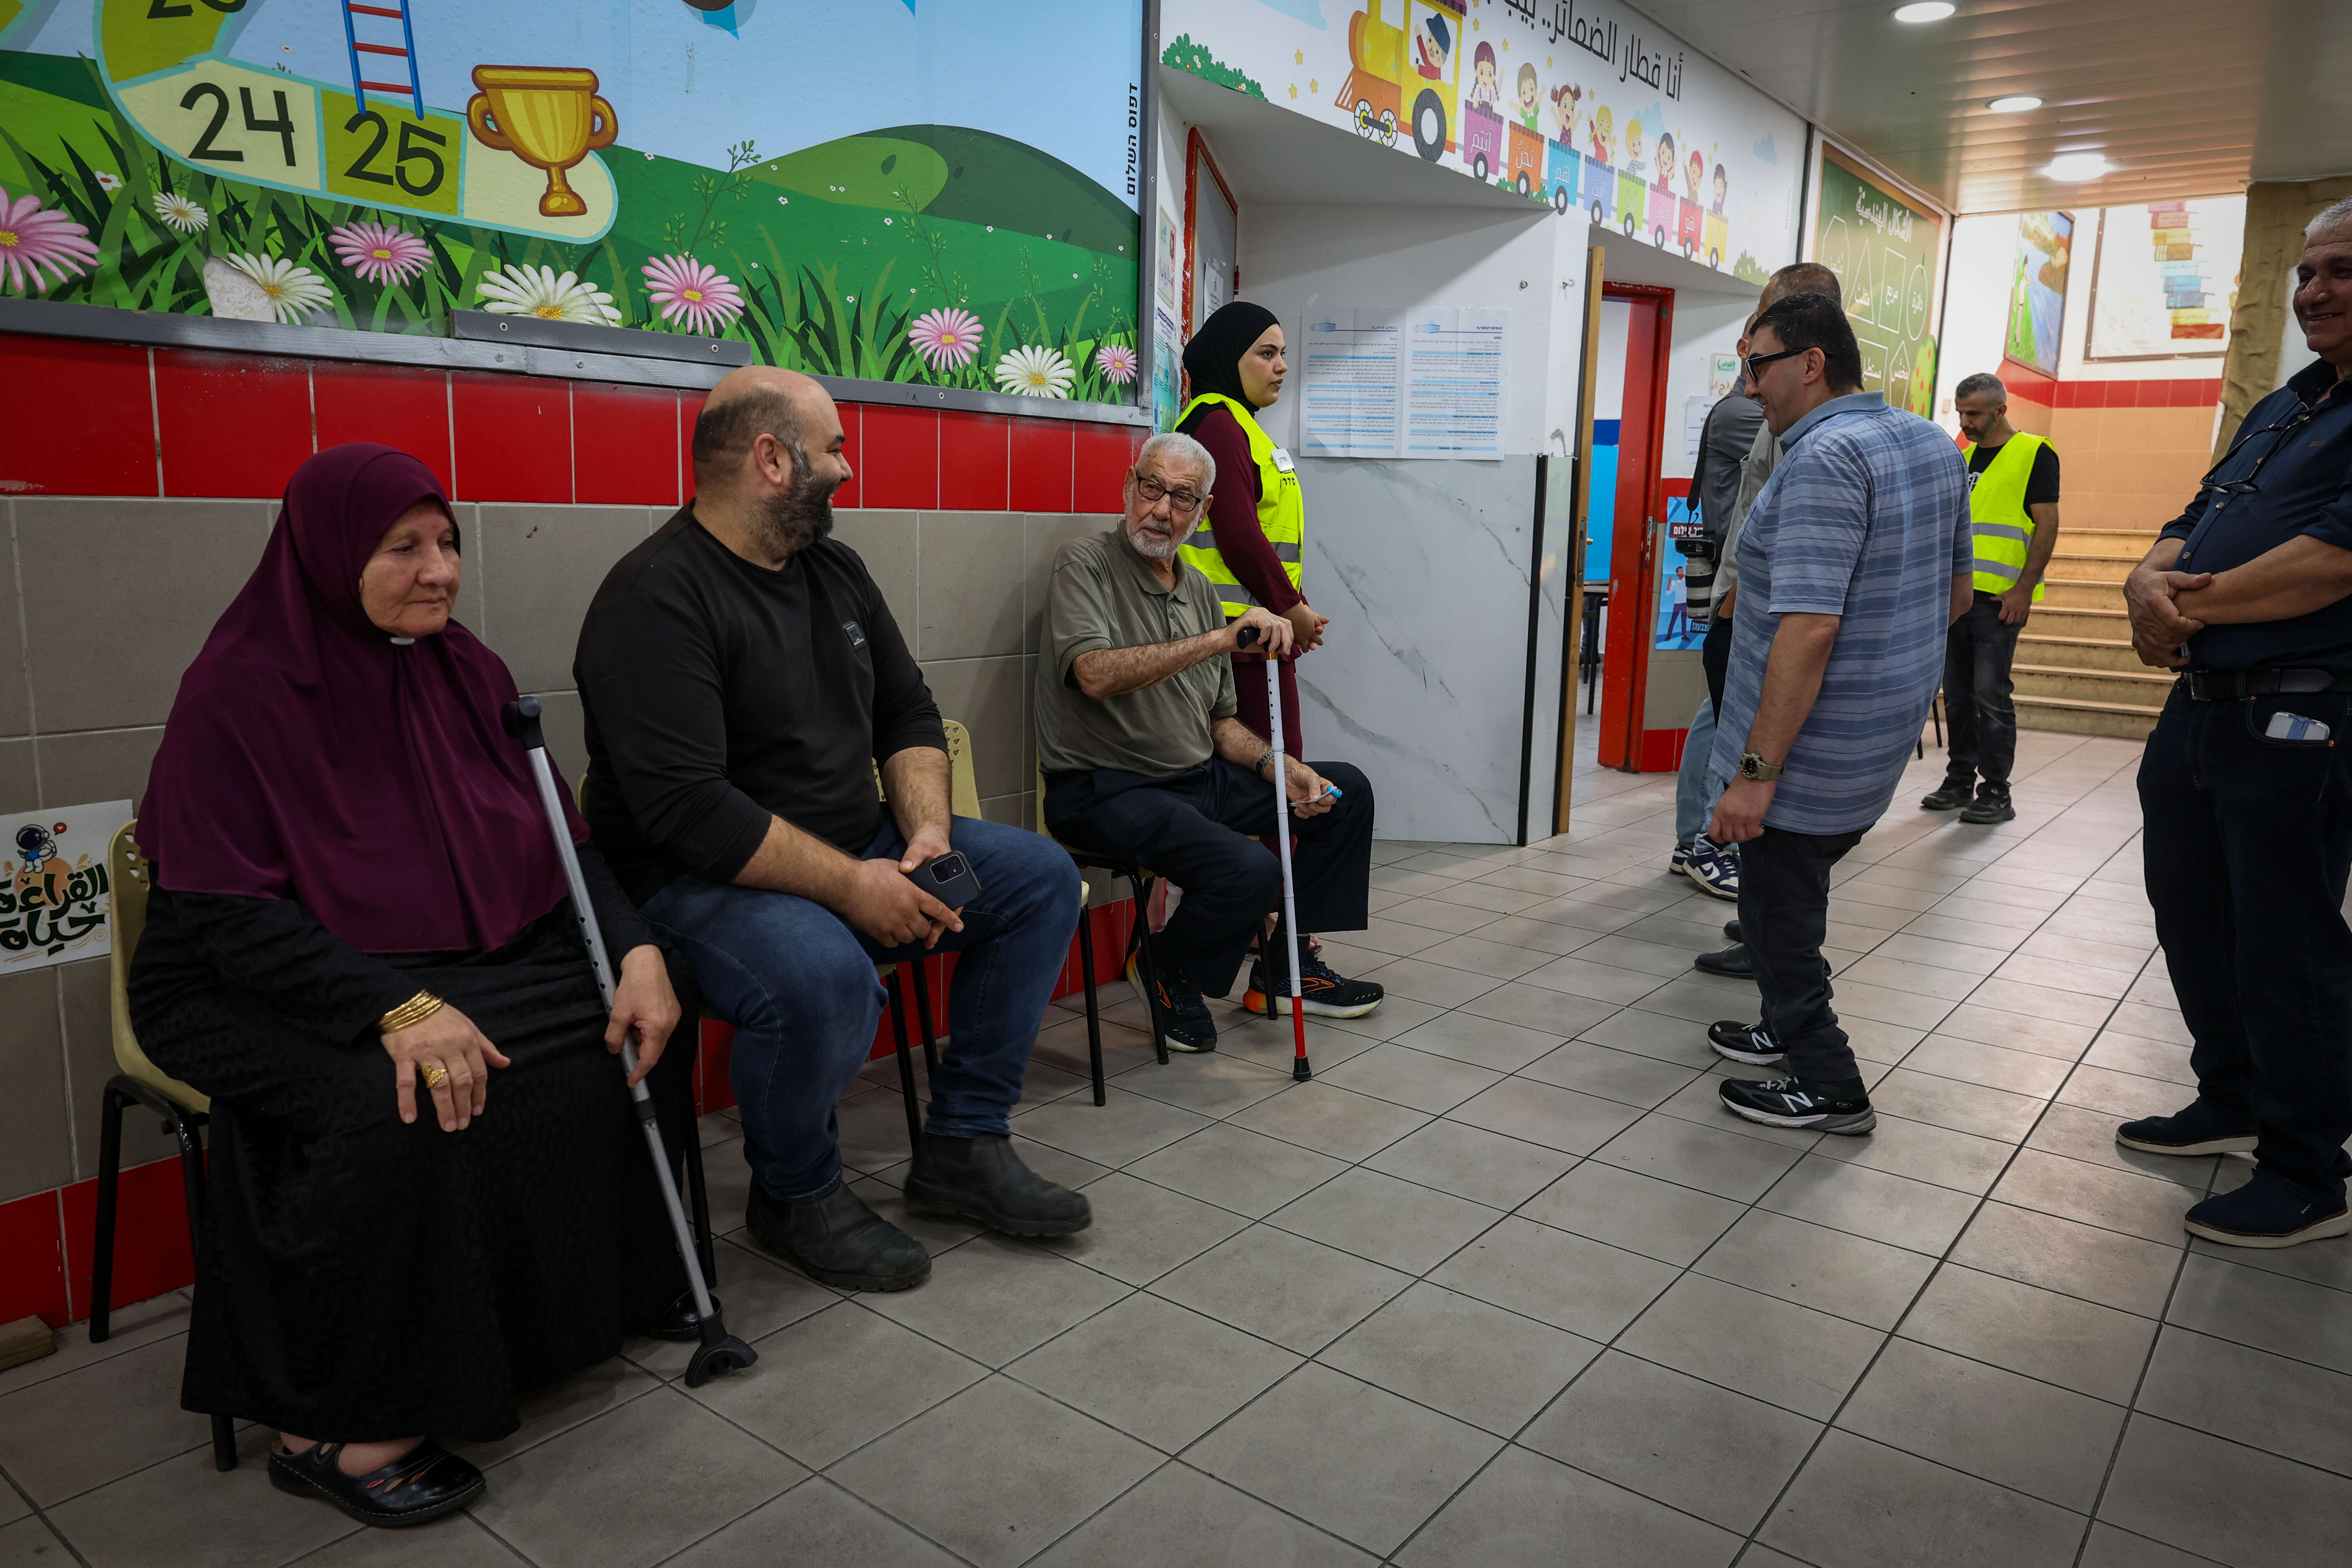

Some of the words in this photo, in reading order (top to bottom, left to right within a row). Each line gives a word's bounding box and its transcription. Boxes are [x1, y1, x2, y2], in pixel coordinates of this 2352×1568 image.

[1619, 34, 1661, 90] قطار
[1666, 52, 1684, 102] أنا
[180, 82, 296, 167] 24
[1129, 82, 1138, 128] דפוס
[343, 110, 446, 196] 25
[1470, 124, 1493, 154] أنتم
[1125, 134, 1136, 195] השלום
[1554, 166, 1570, 186] هم
[1653, 204, 1669, 222] هي
[1684, 216, 1695, 234] هو
[1856, 186, 1888, 234] الهندسية
[1888, 207, 1913, 243] الأشكال
[1854, 283, 1870, 307] مثلث
[1886, 286, 1898, 306] مربع
